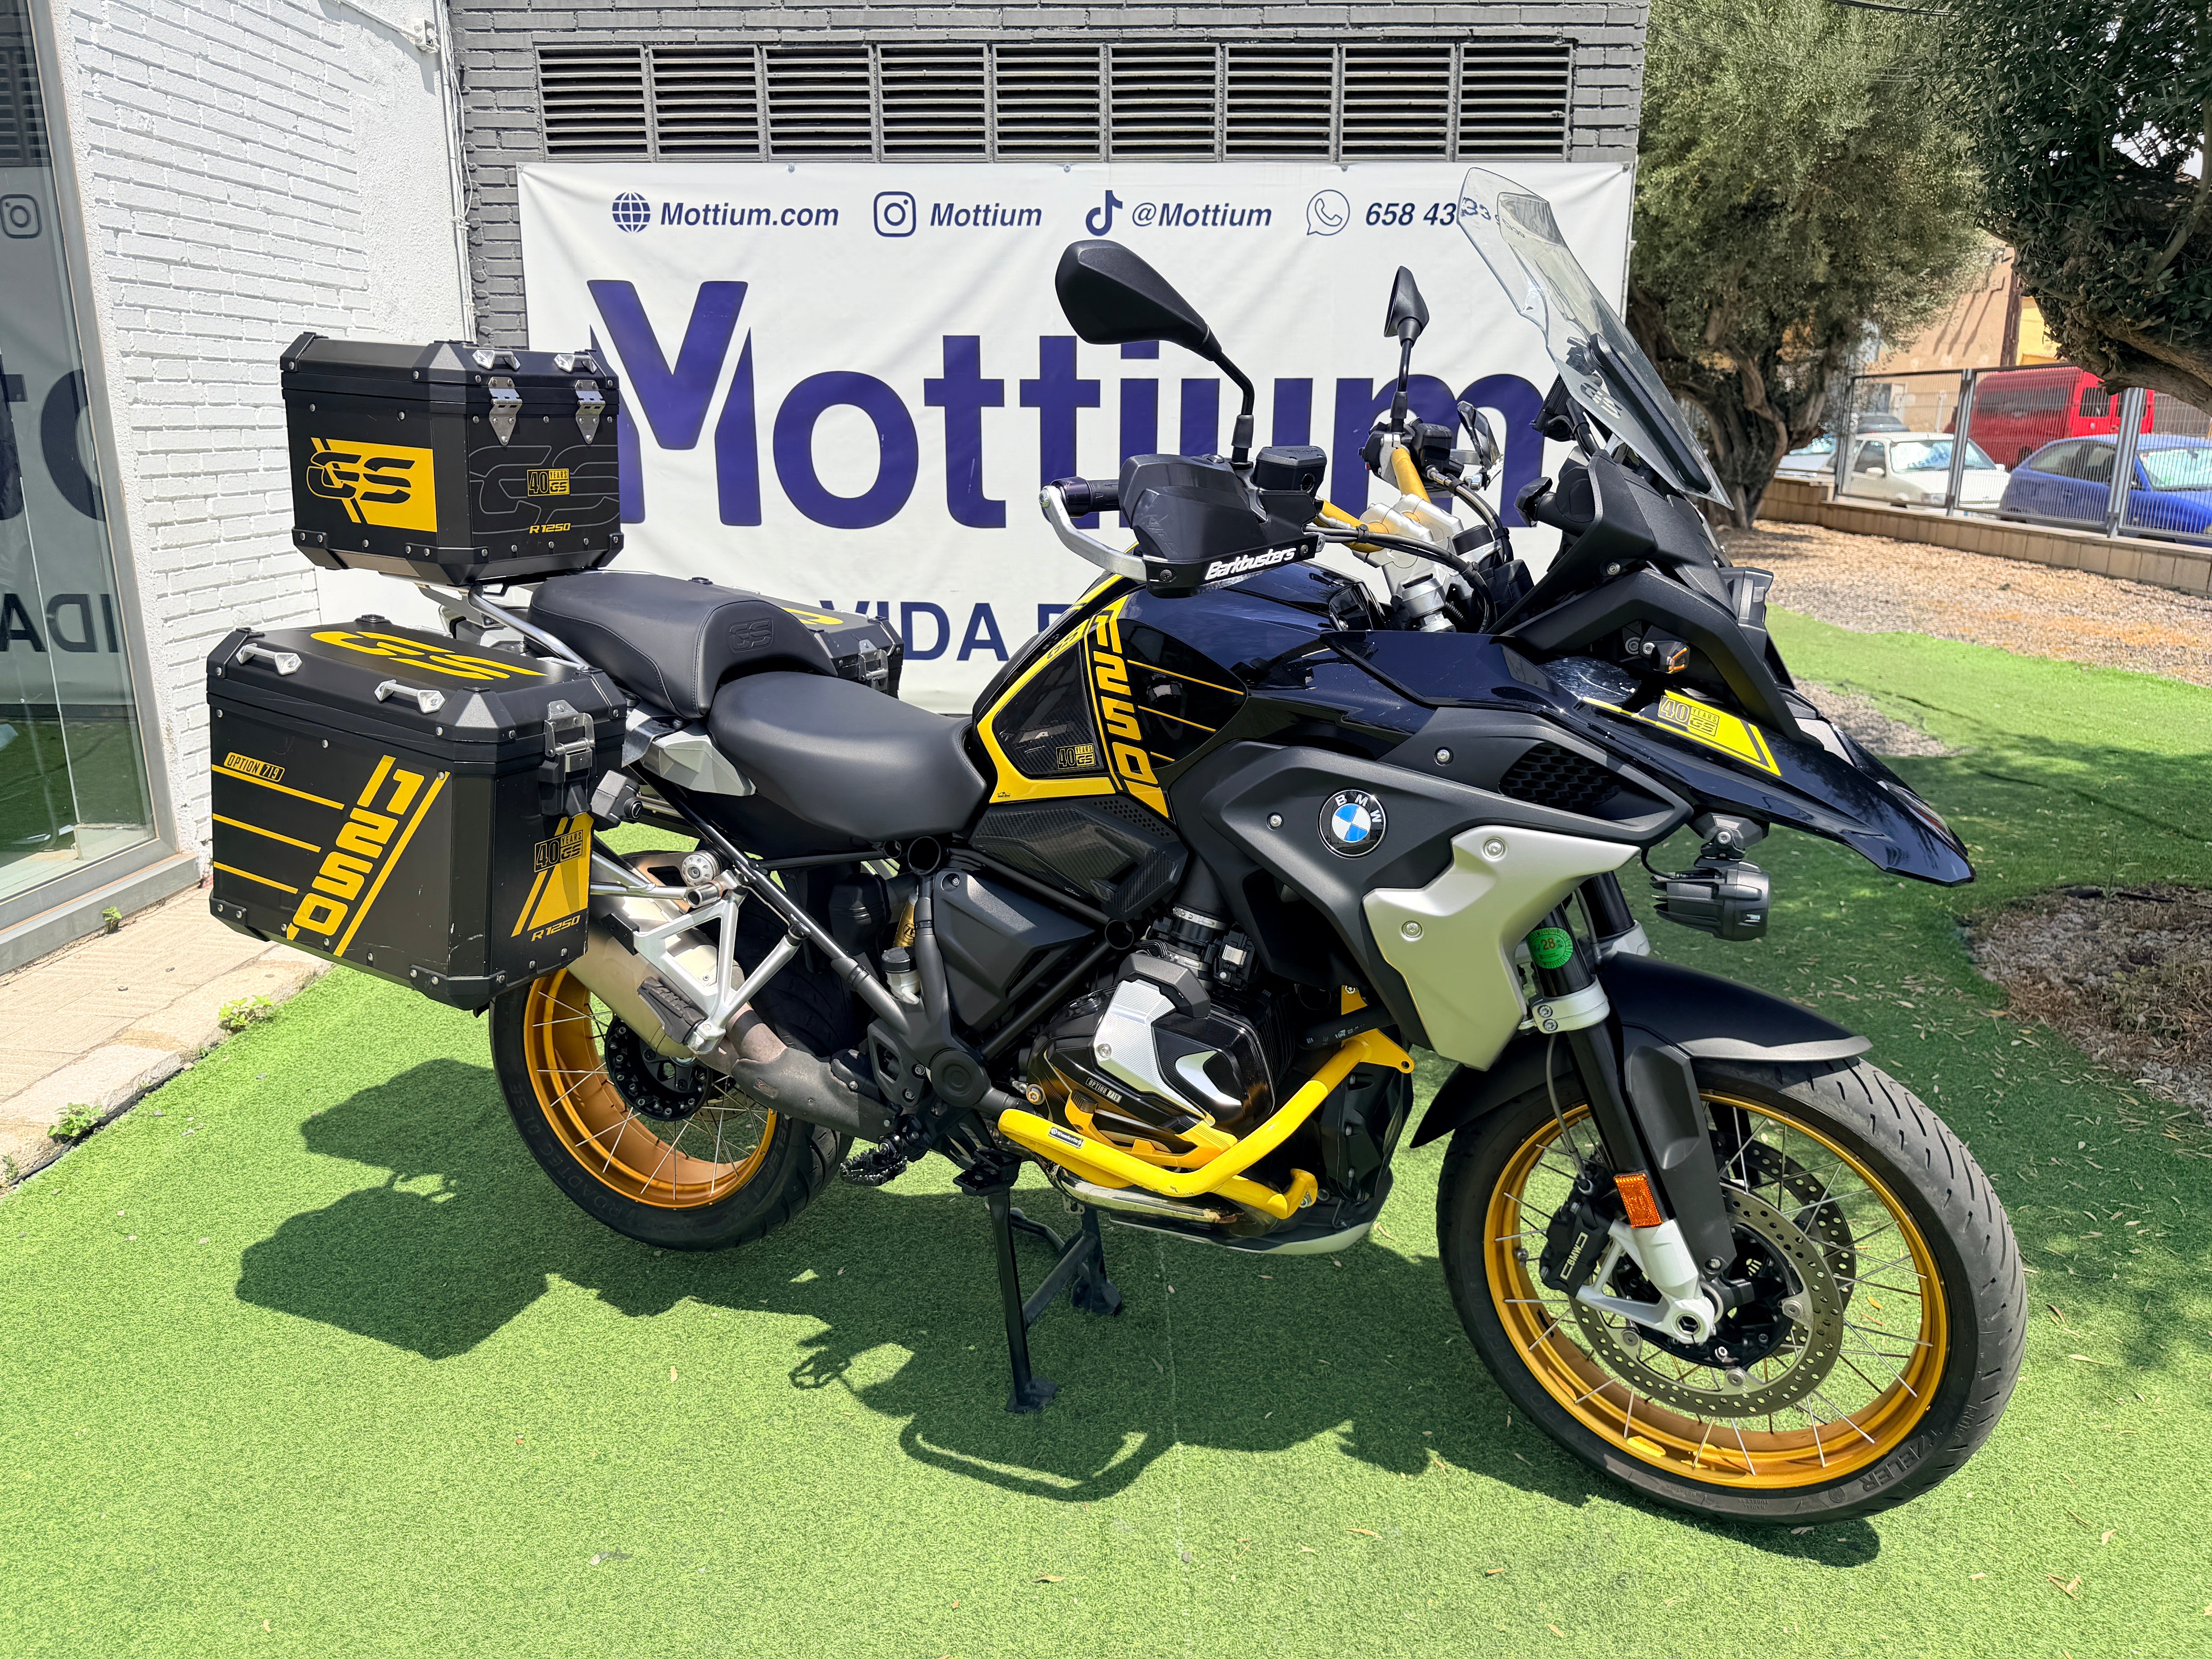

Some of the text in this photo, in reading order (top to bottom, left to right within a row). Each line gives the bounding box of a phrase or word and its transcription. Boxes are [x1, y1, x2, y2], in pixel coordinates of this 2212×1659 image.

[660, 202, 839, 227] Mottium.com
[930, 203, 1042, 227] Mottium
[1132, 202, 1273, 227] @Mottium
[1365, 202, 1416, 226] 658
[306, 450, 415, 505] GS
[529, 471, 568, 494] 40 YEARS
[550, 481, 568, 492] GS
[529, 523, 571, 534] R 1250
[1204, 547, 1297, 580] Barkbusters
[729, 620, 772, 651] GS
[819, 600, 1010, 661] DA
[1661, 699, 1717, 723] 40 YEARS
[1690, 717, 1716, 733] GS
[227, 754, 280, 780] OPTION 719
[1058, 745, 1092, 767] 40 YEARS
[1077, 755, 1093, 764] GS
[1334, 794, 1382, 823] BMW
[536, 831, 582, 868] 40 YEARS
[561, 843, 582, 860] GS
[531, 914, 581, 942] R 1250
[1541, 938, 1556, 950] 28
[1566, 1243, 1582, 1266] BMW
